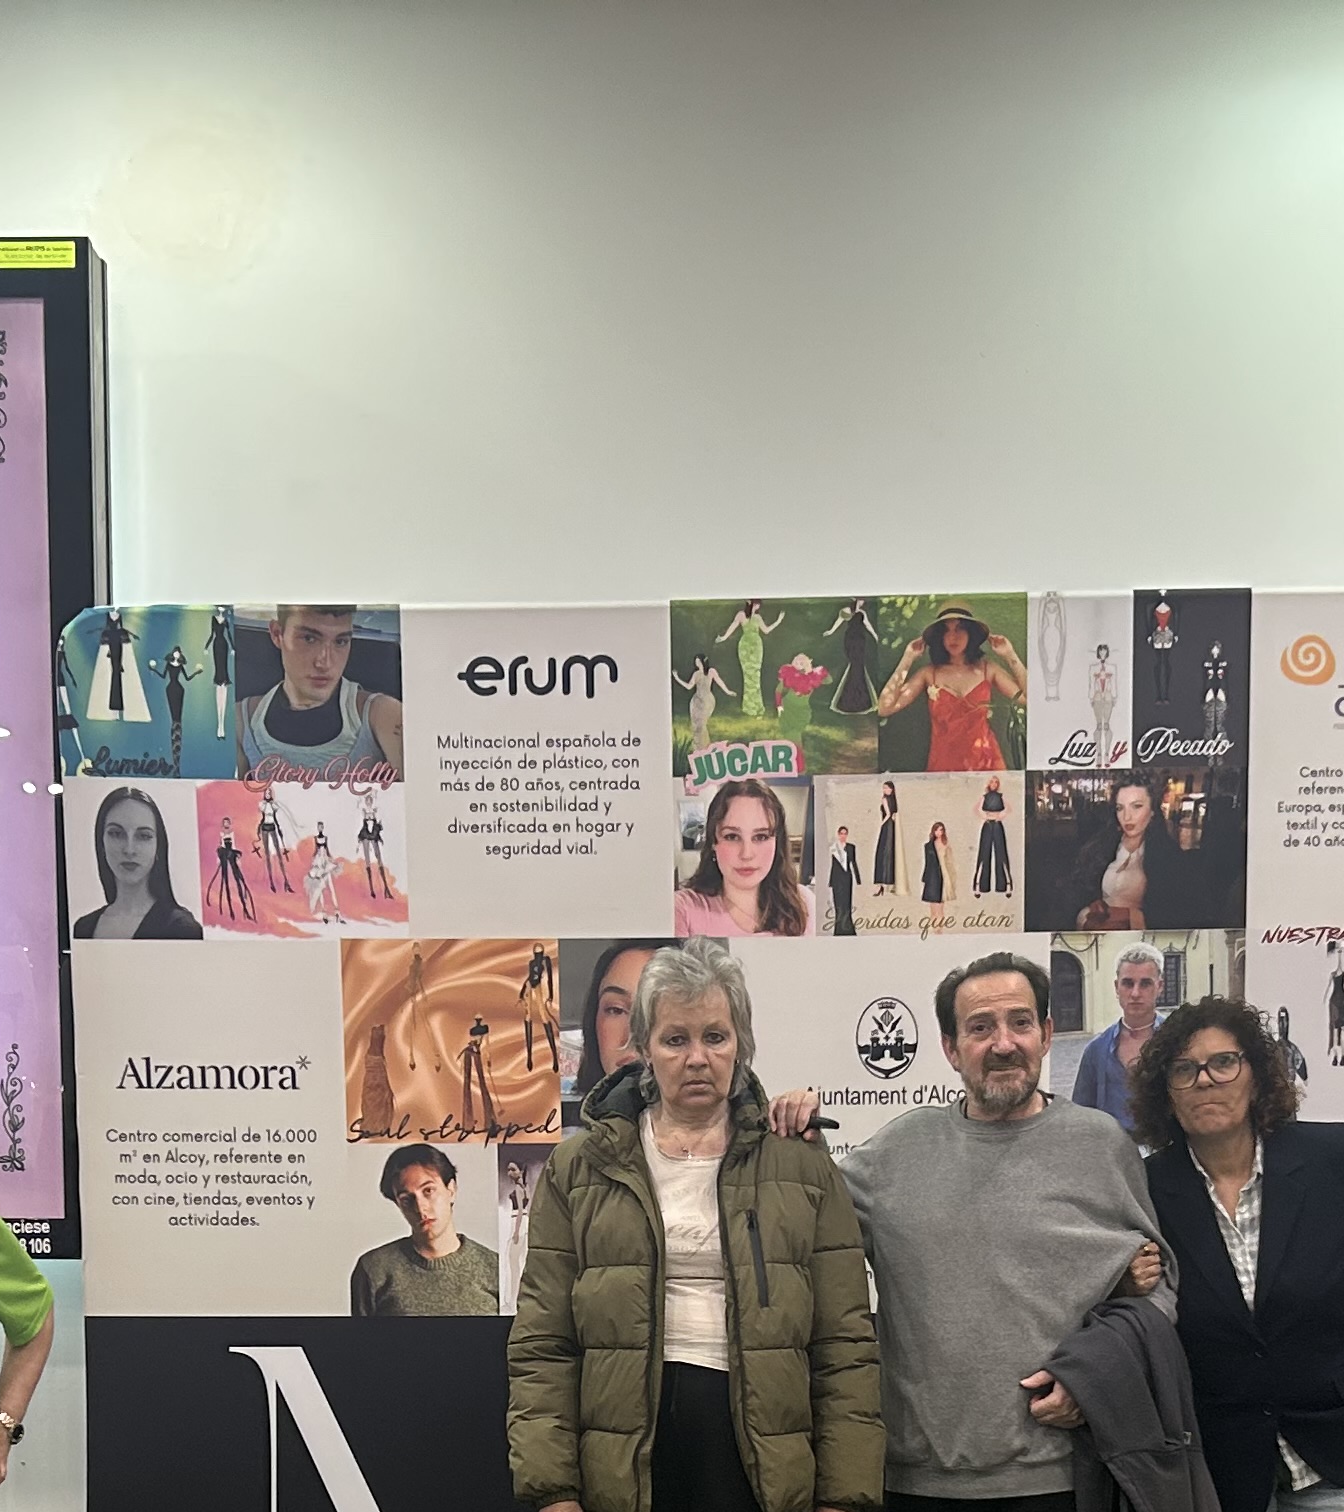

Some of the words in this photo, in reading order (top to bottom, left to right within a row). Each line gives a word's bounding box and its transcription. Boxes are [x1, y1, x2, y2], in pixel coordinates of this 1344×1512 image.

[457, 655, 618, 699] erum
[438, 732, 540, 749] Multinacional
[546, 732, 616, 754] española
[621, 732, 641, 748] de
[1048, 729, 1096, 767] Luz
[1110, 739, 1128, 765] y
[1136, 726, 1235, 765] Pecado
[243, 753, 320, 793] Glory
[325, 753, 399, 796] Holly
[440, 756, 511, 775] inyección
[518, 753, 537, 770] de
[543, 753, 607, 774] plástico,
[612, 758, 639, 770] con
[691, 743, 795, 786] JÚCAR
[1300, 766, 1343, 779] Centro
[441, 775, 469, 792] más
[475, 775, 495, 791] de
[500, 777, 519, 791] 80
[525, 775, 564, 794] años,
[569, 775, 640, 792] centrada
[470, 802, 487, 812] en
[493, 796, 598, 813] sostenibilidad
[604, 801, 612, 816] y
[1278, 800, 1325, 818] Europa,
[448, 817, 548, 834] diversificada
[553, 822, 570, 834] en
[576, 817, 621, 839] hogar
[626, 822, 634, 837] y
[1287, 816, 1318, 832] textil
[1321, 821, 1328, 833] y
[486, 838, 561, 860] seguridad
[567, 838, 598, 855] vial.
[1283, 834, 1300, 848] de
[1304, 832, 1323, 847] 40
[918, 911, 957, 941] que
[963, 911, 1013, 931] atan
[807, 1086, 908, 1106] juntament
[913, 1084, 967, 1106] d'Alco
[106, 1128, 157, 1143] Centro
[162, 1127, 236, 1143] comercial
[242, 1126, 261, 1143] de
[346, 1111, 411, 1143] Soul
[421, 1107, 560, 1151] stripped
[143, 1153, 160, 1165] en
[165, 1147, 209, 1168] Alcoy,
[214, 1147, 282, 1164] referente
[288, 1153, 305, 1164] en
[115, 1168, 161, 1186] moda,
[165, 1172, 197, 1184] ocio
[202, 1174, 210, 1189] y
[215, 1171, 312, 1190] restauración,
[112, 1195, 138, 1205] con
[144, 1192, 179, 1207] cine,
[183, 1189, 242, 1211] tiendas,
[246, 1192, 302, 1205] eventos
[307, 1195, 315, 1210] y
[169, 1210, 259, 1227] actividades.
